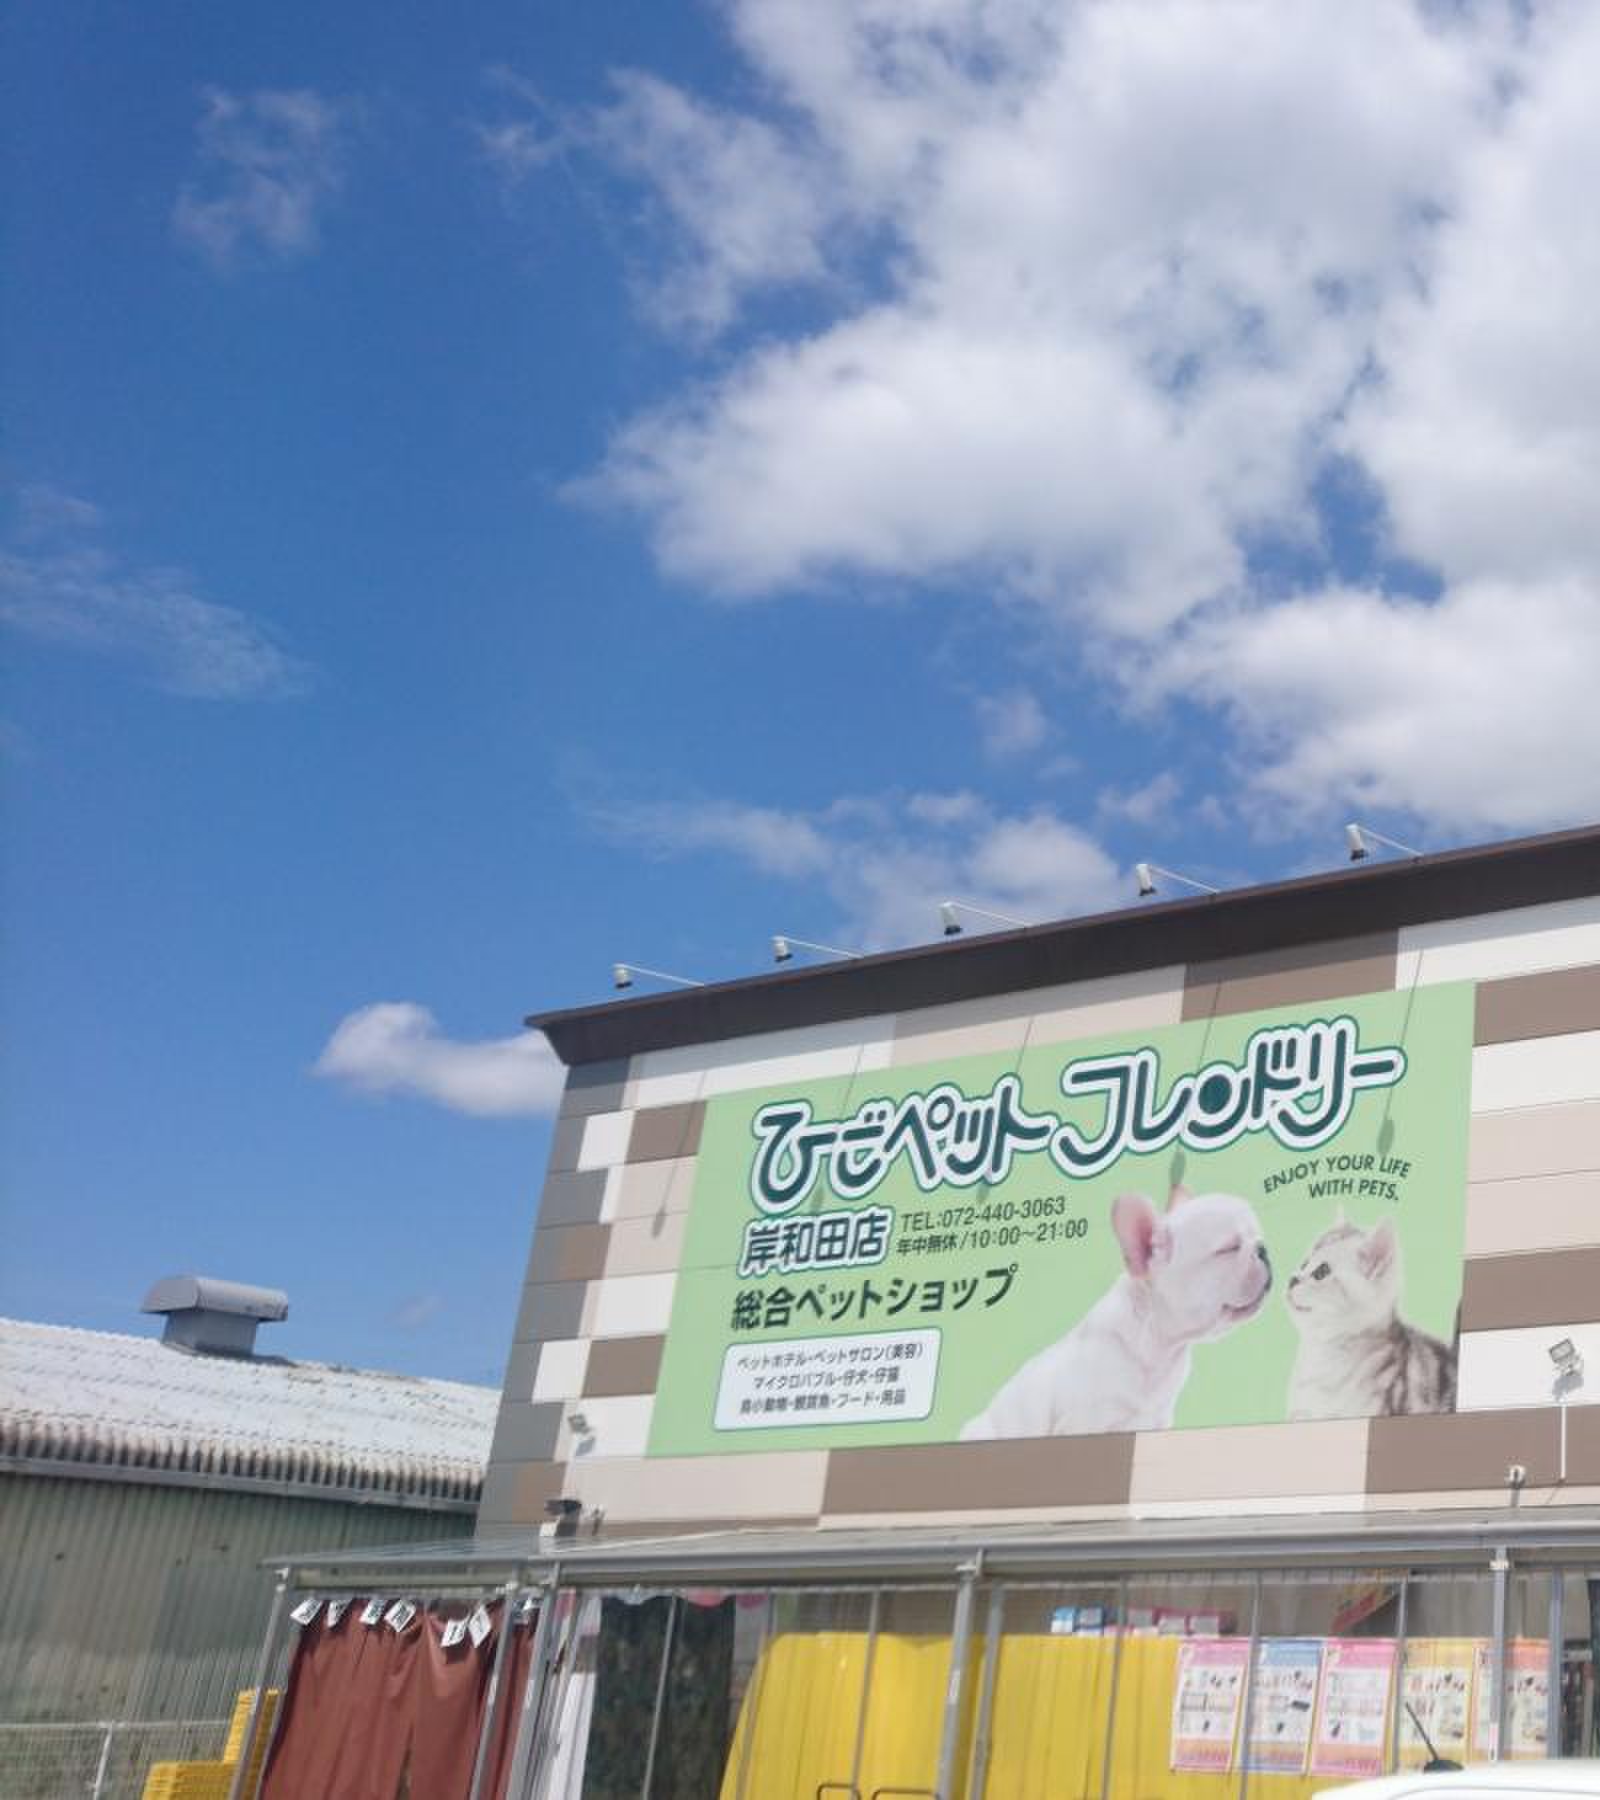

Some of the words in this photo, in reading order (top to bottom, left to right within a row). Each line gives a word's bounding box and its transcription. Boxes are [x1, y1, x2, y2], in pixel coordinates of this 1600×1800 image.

[1264, 1159, 1319, 1193] ENJOY
[1326, 1154, 1375, 1172] YOUR
[1379, 1156, 1412, 1178] LIFE
[1309, 1179, 1352, 1198] WITH
[1359, 1179, 1399, 1200] PETS.
[902, 1196, 1066, 1233] TEL:072-440-3063
[740, 1208, 892, 1275] 岸和田店
[731, 1263, 1018, 1330] 総合ペットショップ
